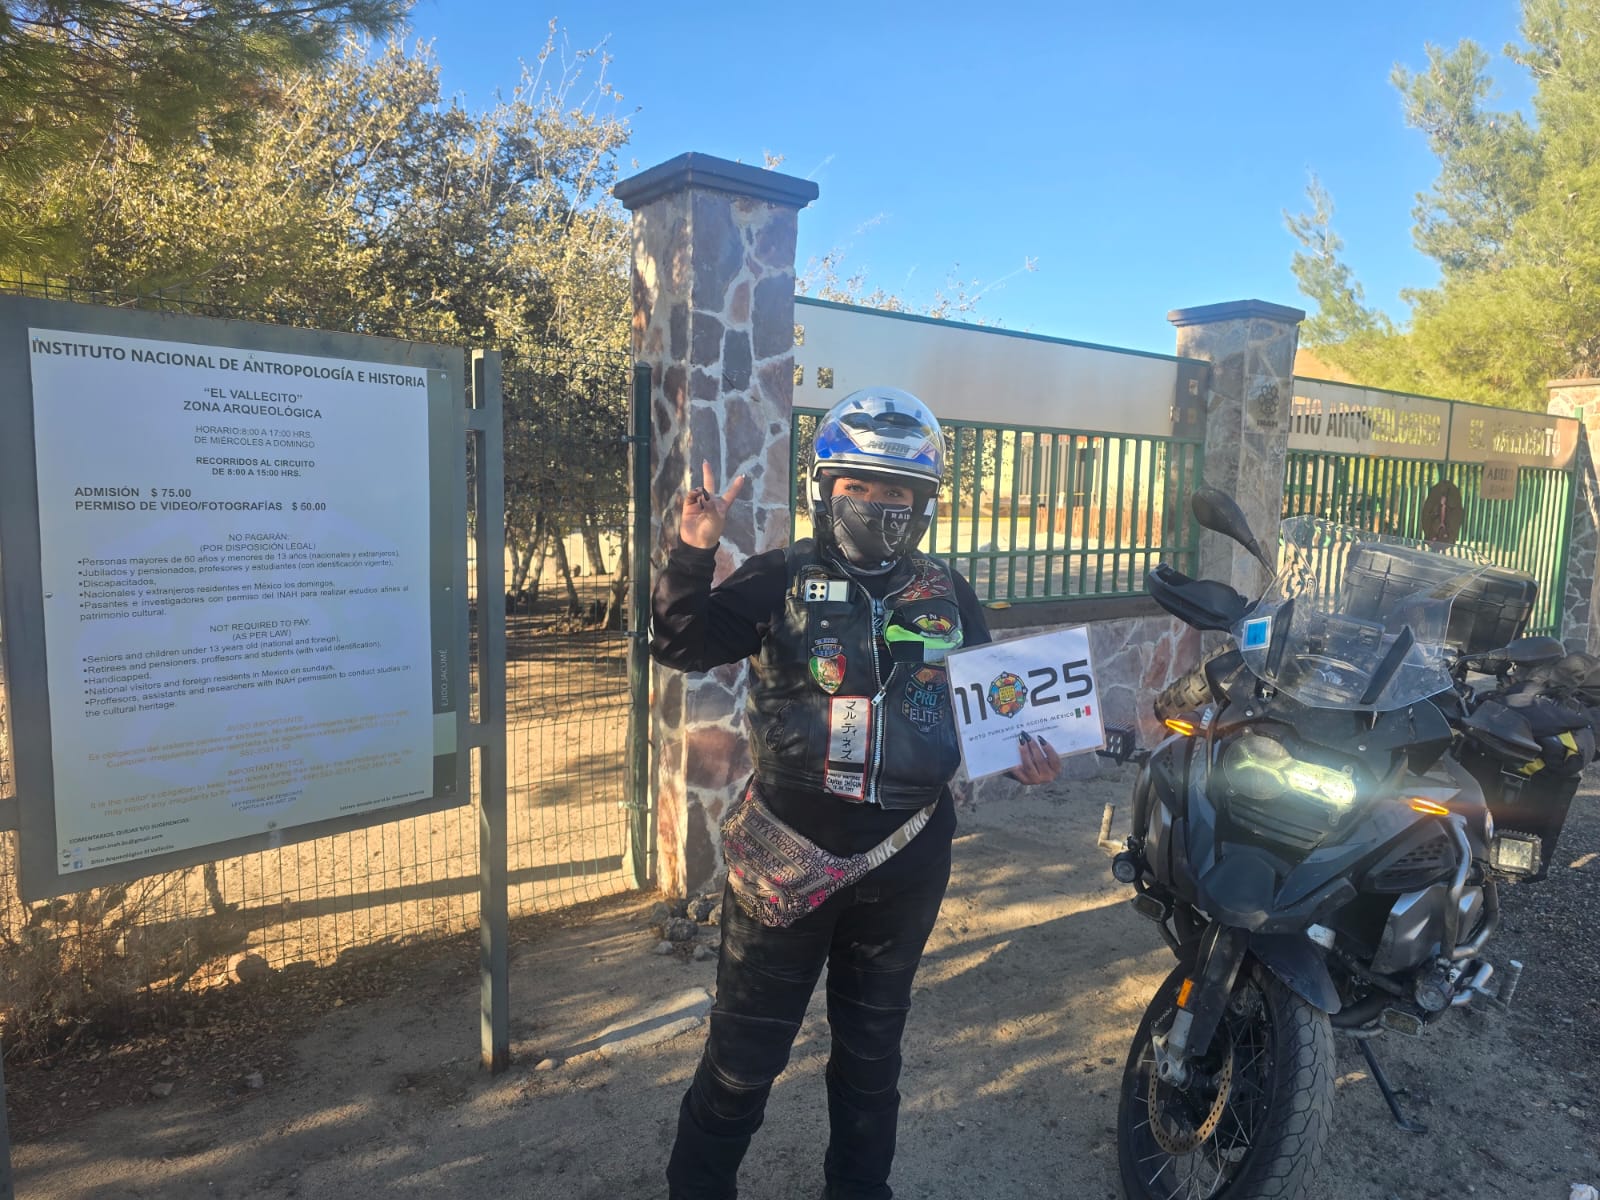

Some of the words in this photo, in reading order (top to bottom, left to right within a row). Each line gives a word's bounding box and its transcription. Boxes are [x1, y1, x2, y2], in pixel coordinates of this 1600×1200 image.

[32, 339, 126, 361] INSTITUTO
[132, 349, 215, 369] NACIONAL
[220, 358, 238, 371] DE
[242, 360, 354, 382] ANTROPOLOGÍA
[358, 371, 365, 382] E
[368, 372, 425, 388] HISTORIA
[184, 400, 220, 412] ZONA
[223, 403, 322, 419] ARQUEOLÓGICA
[260, 428, 267, 436] A
[270, 428, 291, 438] 17:00
[292, 430, 312, 438] HRS.
[194, 436, 208, 444] DE
[210, 436, 264, 446] MIÉRCOLES
[273, 439, 315, 448] DOMINGO
[196, 457, 258, 466] RECORRIDOS
[260, 458, 272, 466] AL
[274, 459, 316, 468] CIRCUITO
[212, 468, 225, 476] DE
[248, 468, 254, 476] A
[256, 469, 278, 477] 15:00
[281, 470, 301, 478] HRS.
[74, 486, 140, 497] ADMISIÓN
[151, 488, 158, 498] $
[162, 488, 192, 498] 75.00
[75, 501, 136, 511] PERMISO
[140, 501, 156, 511] DE
[159, 500, 282, 512] VIDEO/FOTOGRAFÍAS
[292, 502, 298, 511] $
[200, 544, 224, 552] (POR
[226, 542, 284, 552] DISPOSICIÓN
[286, 542, 316, 551] LEGAL)
[130, 558, 168, 566] mayores
[171, 555, 182, 563] de
[197, 554, 218, 563] años
[264, 552, 274, 561] de
[277, 552, 286, 560] 13
[289, 552, 307, 560] años
[310, 550, 350, 561] (nacionales
[138, 565, 196, 576] pensionados,
[199, 563, 243, 574] profesores
[252, 561, 296, 571] estudiantes
[299, 561, 315, 571] (con
[141, 595, 204, 608] investigadores
[227, 592, 258, 603] permiso
[262, 591, 274, 600] del
[277, 590, 298, 599] INAH
[300, 591, 317, 599] para
[320, 587, 346, 596] realizar
[381, 584, 400, 593] afines
[146, 586, 195, 597] extranjeros
[197, 583, 240, 593] residentes
[254, 581, 282, 590] México
[284, 580, 295, 589] los
[80, 610, 129, 622] patrimonio
[132, 607, 166, 618] cultural.
[210, 624, 230, 632] NOT
[232, 620, 278, 630] REQUIRED
[232, 633, 247, 641] (AS
[270, 630, 292, 638] LAW)
[125, 651, 142, 660] and
[145, 648, 180, 659] children
[182, 646, 206, 655] under
[210, 644, 219, 653] 13
[221, 644, 243, 654] years
[245, 641, 258, 650] old
[260, 638, 292, 650] (national
[295, 637, 309, 646] and
[129, 661, 146, 670] and
[245, 651, 259, 660] and
[261, 648, 294, 658] students
[296, 646, 313, 657] (with
[316, 644, 332, 653] valid
[130, 681, 162, 692] visitors
[164, 679, 180, 688] and
[182, 676, 211, 688] foreign
[214, 672, 250, 683] residents
[142, 688, 186, 701] assistants
[189, 686, 204, 696] and
[208, 681, 254, 694] researchers
[257, 679, 272, 688] with
[275, 676, 295, 686] INAH
[298, 671, 337, 685] permission
[348, 667, 375, 678] conduct
[377, 664, 400, 674] studies
[914, 691, 936, 706] PRO
[86, 708, 100, 718] the
[103, 704, 136, 716] cultural
[910, 706, 939, 723] ELITE
[841, 701, 857, 761] マルティネス
[904, 808, 929, 842] PINK
